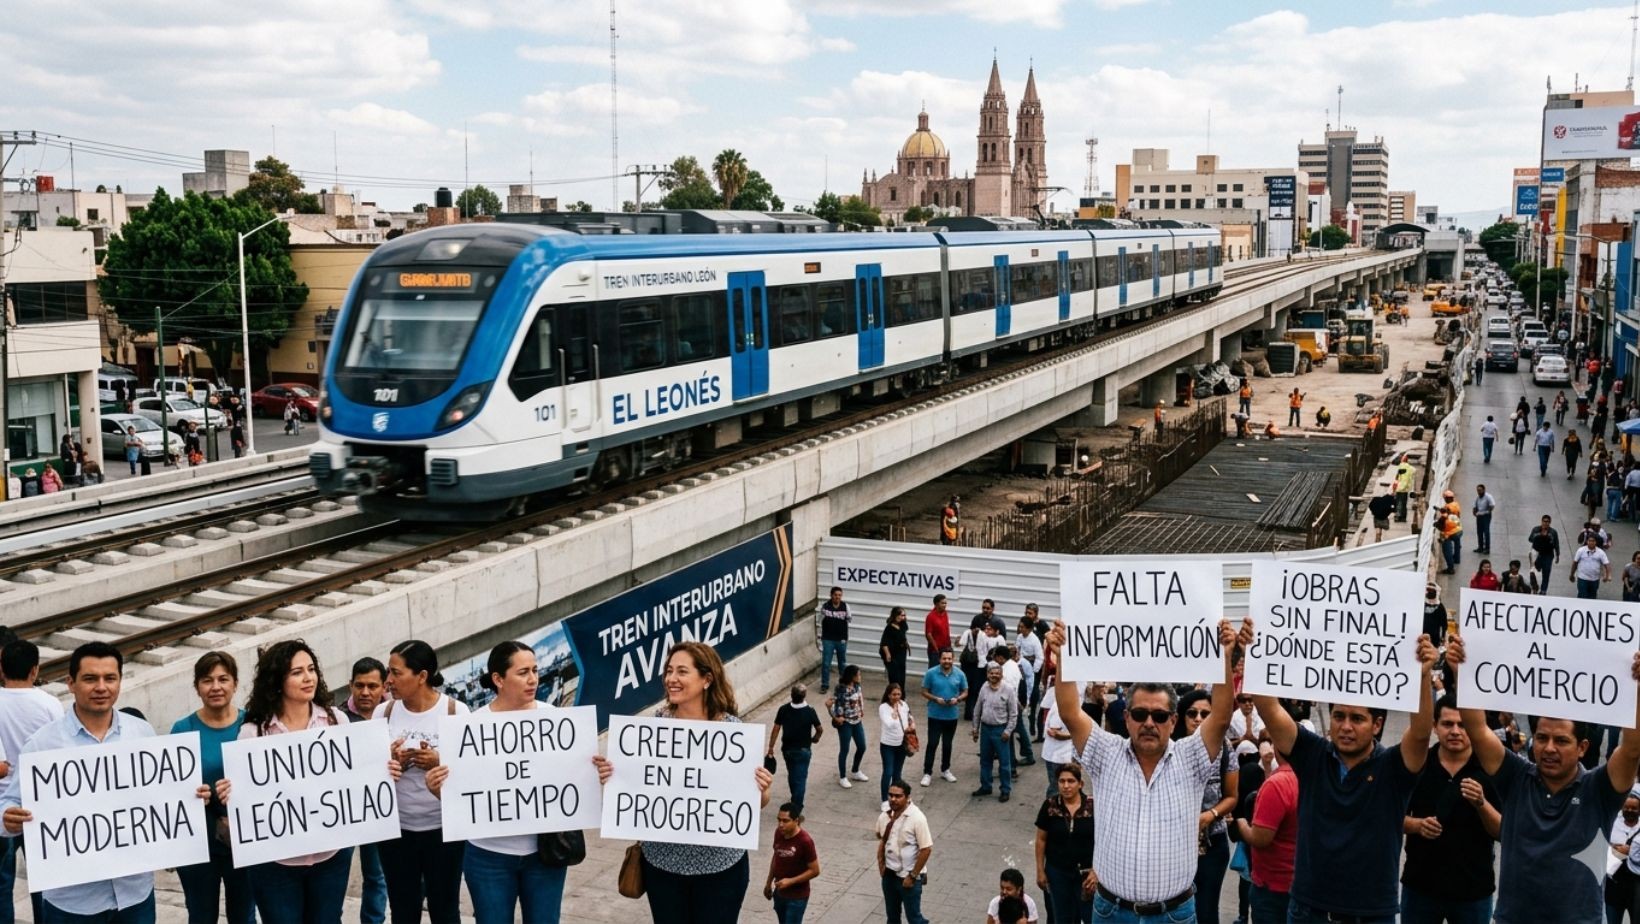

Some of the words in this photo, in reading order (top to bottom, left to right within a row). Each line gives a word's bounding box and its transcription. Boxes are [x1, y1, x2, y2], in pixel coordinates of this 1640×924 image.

[603, 274, 629, 289] TREN
[694, 266, 716, 283] LEÓN
[373, 388, 398, 402] 101
[533, 404, 557, 422] 101
[612, 392, 639, 425] EL
[645, 371, 721, 418] LEONÉS
[837, 566, 955, 592] EXPECTATIVAS
[1093, 571, 1187, 606] FALTA
[1282, 569, 1380, 606] ¡OBRAS
[598, 611, 649, 656] TREN
[653, 559, 766, 632] INTERURBANO
[1270, 605, 1311, 630] SIN
[1324, 609, 1407, 639] FINAL!
[1464, 599, 1635, 643] AFECTACIONES
[1067, 618, 1221, 659] INFORMACIÓN
[1250, 632, 1335, 662] ¿DÓNDE
[1346, 640, 1401, 668] ESTÁ
[1527, 641, 1556, 661] AL
[1266, 663, 1293, 687] EL
[1304, 666, 1409, 701] DINERO?
[1475, 661, 1619, 706] COMERCIO
[459, 717, 576, 758] AHORRO
[618, 724, 746, 764] CREEMOS
[31, 746, 196, 801] MOVILIDAD
[248, 730, 353, 786] UNIÓN
[505, 760, 531, 781] DE
[644, 764, 672, 787] EN
[684, 767, 710, 789] EL
[235, 781, 394, 845] LEÓN-SILAO
[461, 783, 580, 824] TIEMPO
[616, 793, 753, 836] PROGRESO
[39, 800, 194, 860] MODERNA
